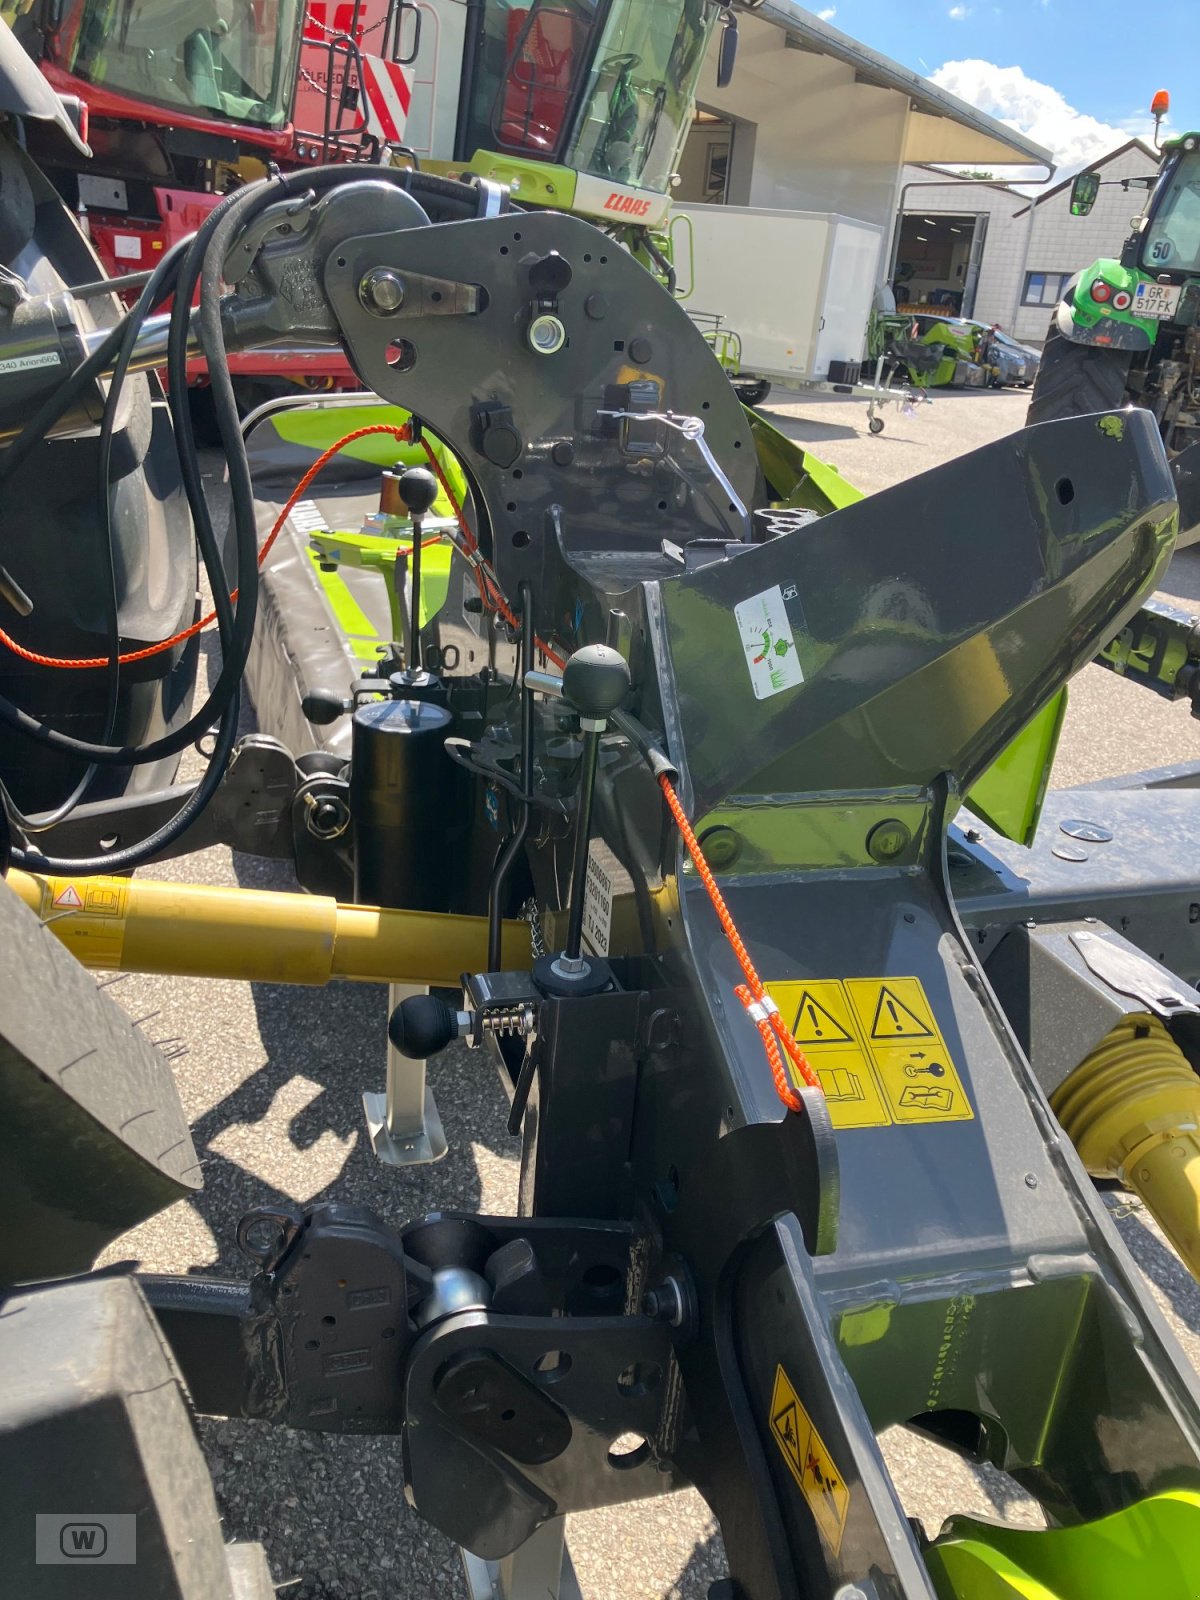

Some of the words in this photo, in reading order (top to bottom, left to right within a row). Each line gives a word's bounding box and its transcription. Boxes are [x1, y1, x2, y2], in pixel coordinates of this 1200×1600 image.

[604, 193, 652, 216] CLAAS
[1153, 242, 1170, 259] 50
[1149, 287, 1163, 298] GR
[1137, 299, 1156, 310] 517
[1157, 300, 1173, 313] FK
